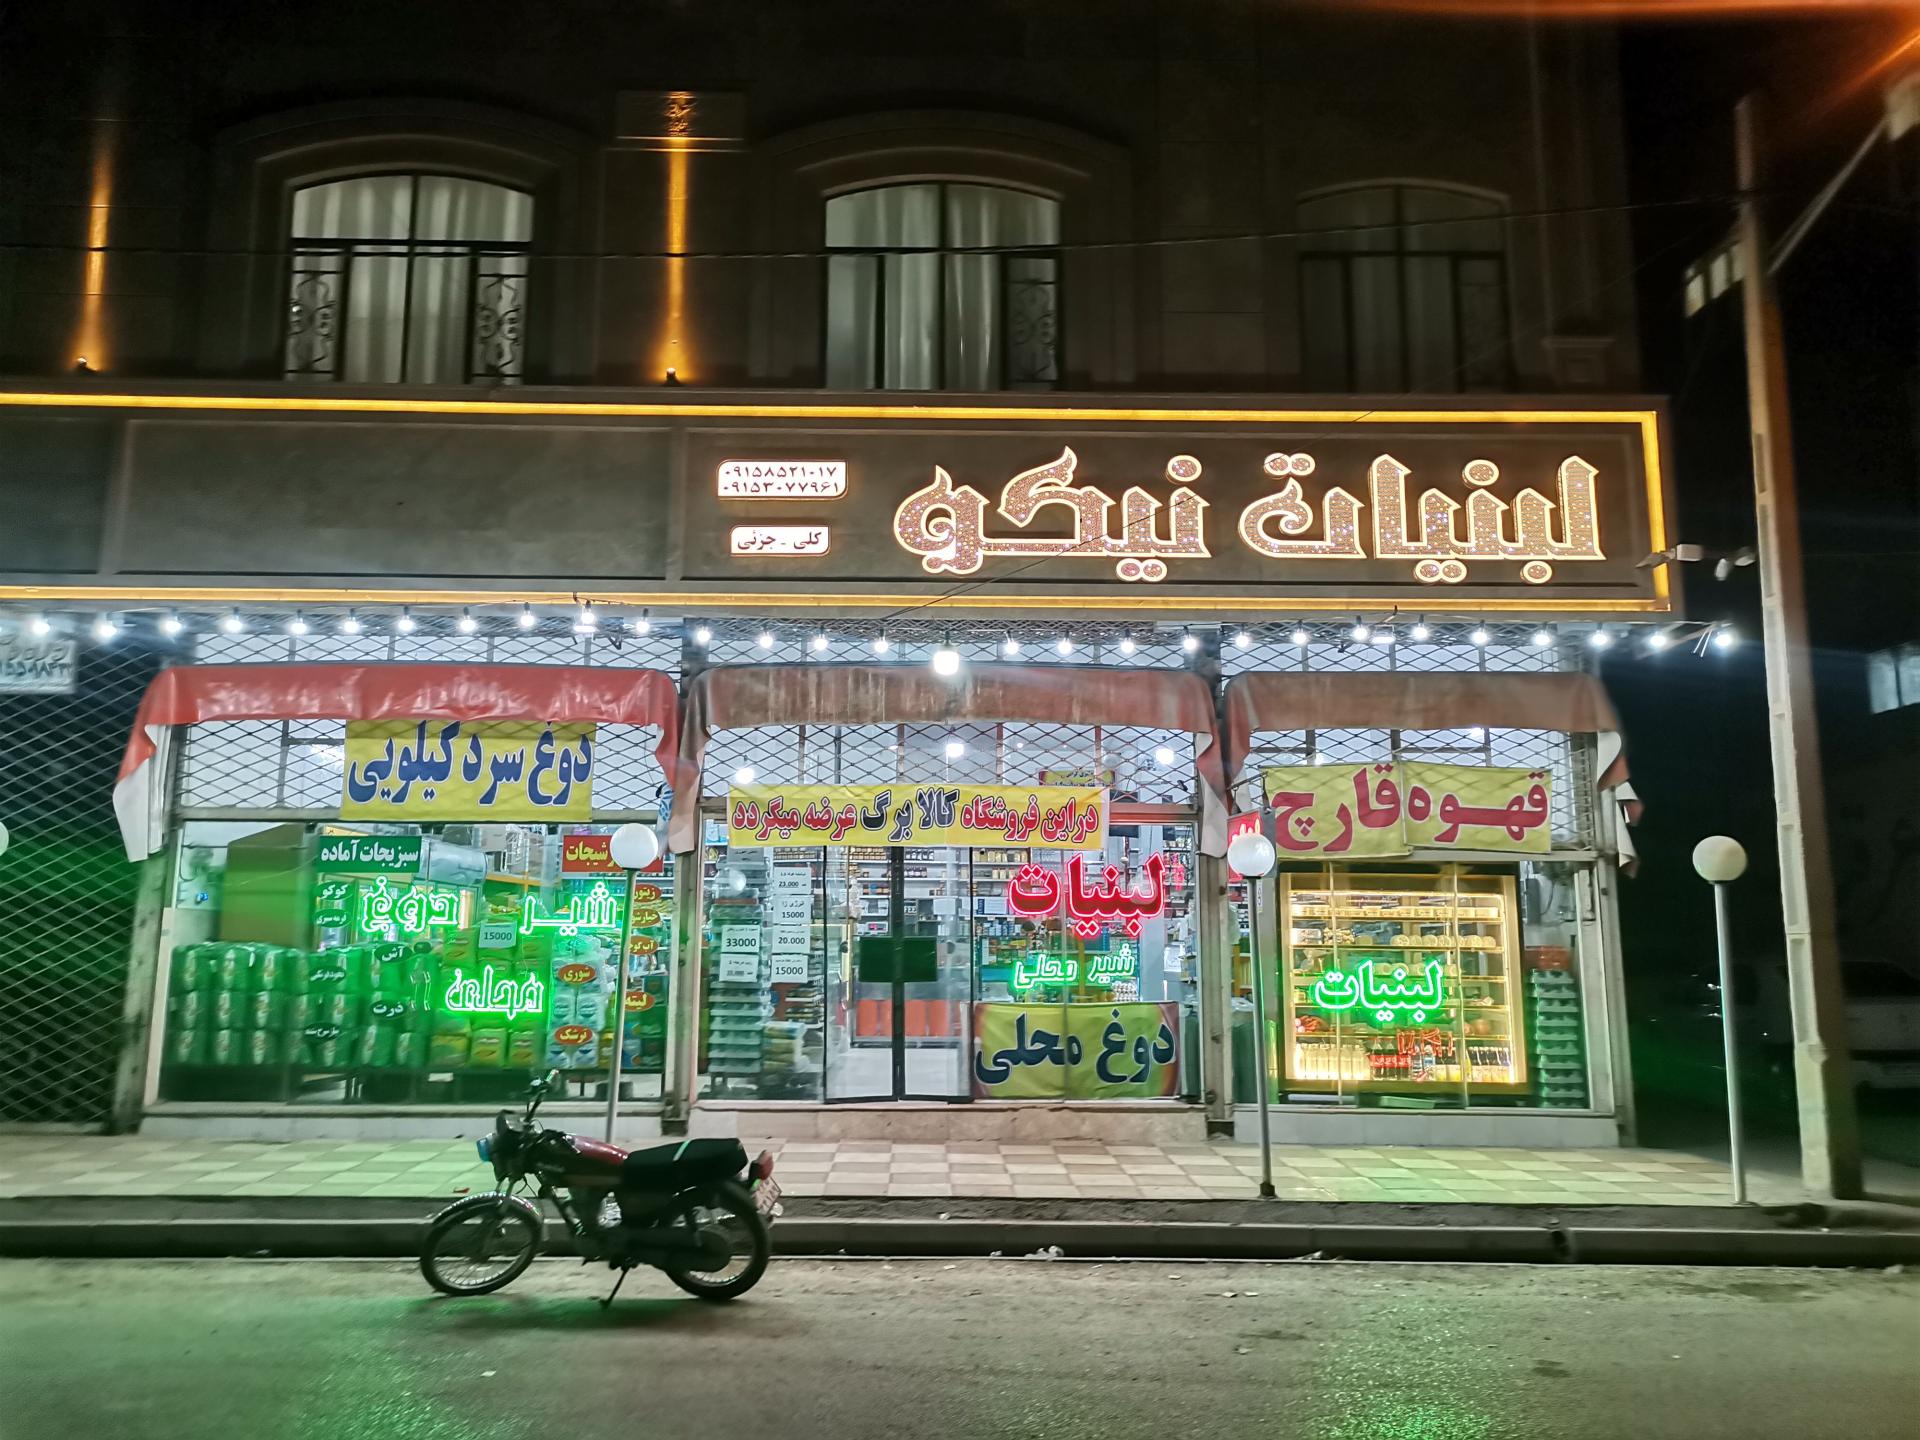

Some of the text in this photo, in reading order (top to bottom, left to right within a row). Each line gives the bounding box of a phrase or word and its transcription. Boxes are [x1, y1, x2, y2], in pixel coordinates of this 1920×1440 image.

[894, 446, 1606, 584] لبنیات نیکو
[793, 532, 822, 550] کلی
[347, 720, 593, 806] دوغ سرد کیلویی
[731, 795, 801, 840] میگردد
[803, 797, 857, 840] عرضه
[961, 794, 1040, 842] فروشگاه
[1271, 762, 1549, 852] قهوه قارچ
[321, 839, 419, 868] سبزیجات آماده
[320, 884, 348, 899] کوکو
[362, 875, 459, 934] دوغ
[519, 881, 617, 936] شیر
[1009, 852, 1166, 937] لبنیات
[381, 946, 404, 961] آش
[484, 931, 512, 939] 15000
[726, 938, 757, 946] 33000
[775, 966, 803, 974] 15000
[1014, 943, 1136, 989] شیر محلی
[373, 1002, 404, 1017] ذرت
[446, 964, 544, 1020] محلی
[1315, 960, 1443, 1023] لبنیات
[975, 1008, 1176, 1085] دوغ محلی
